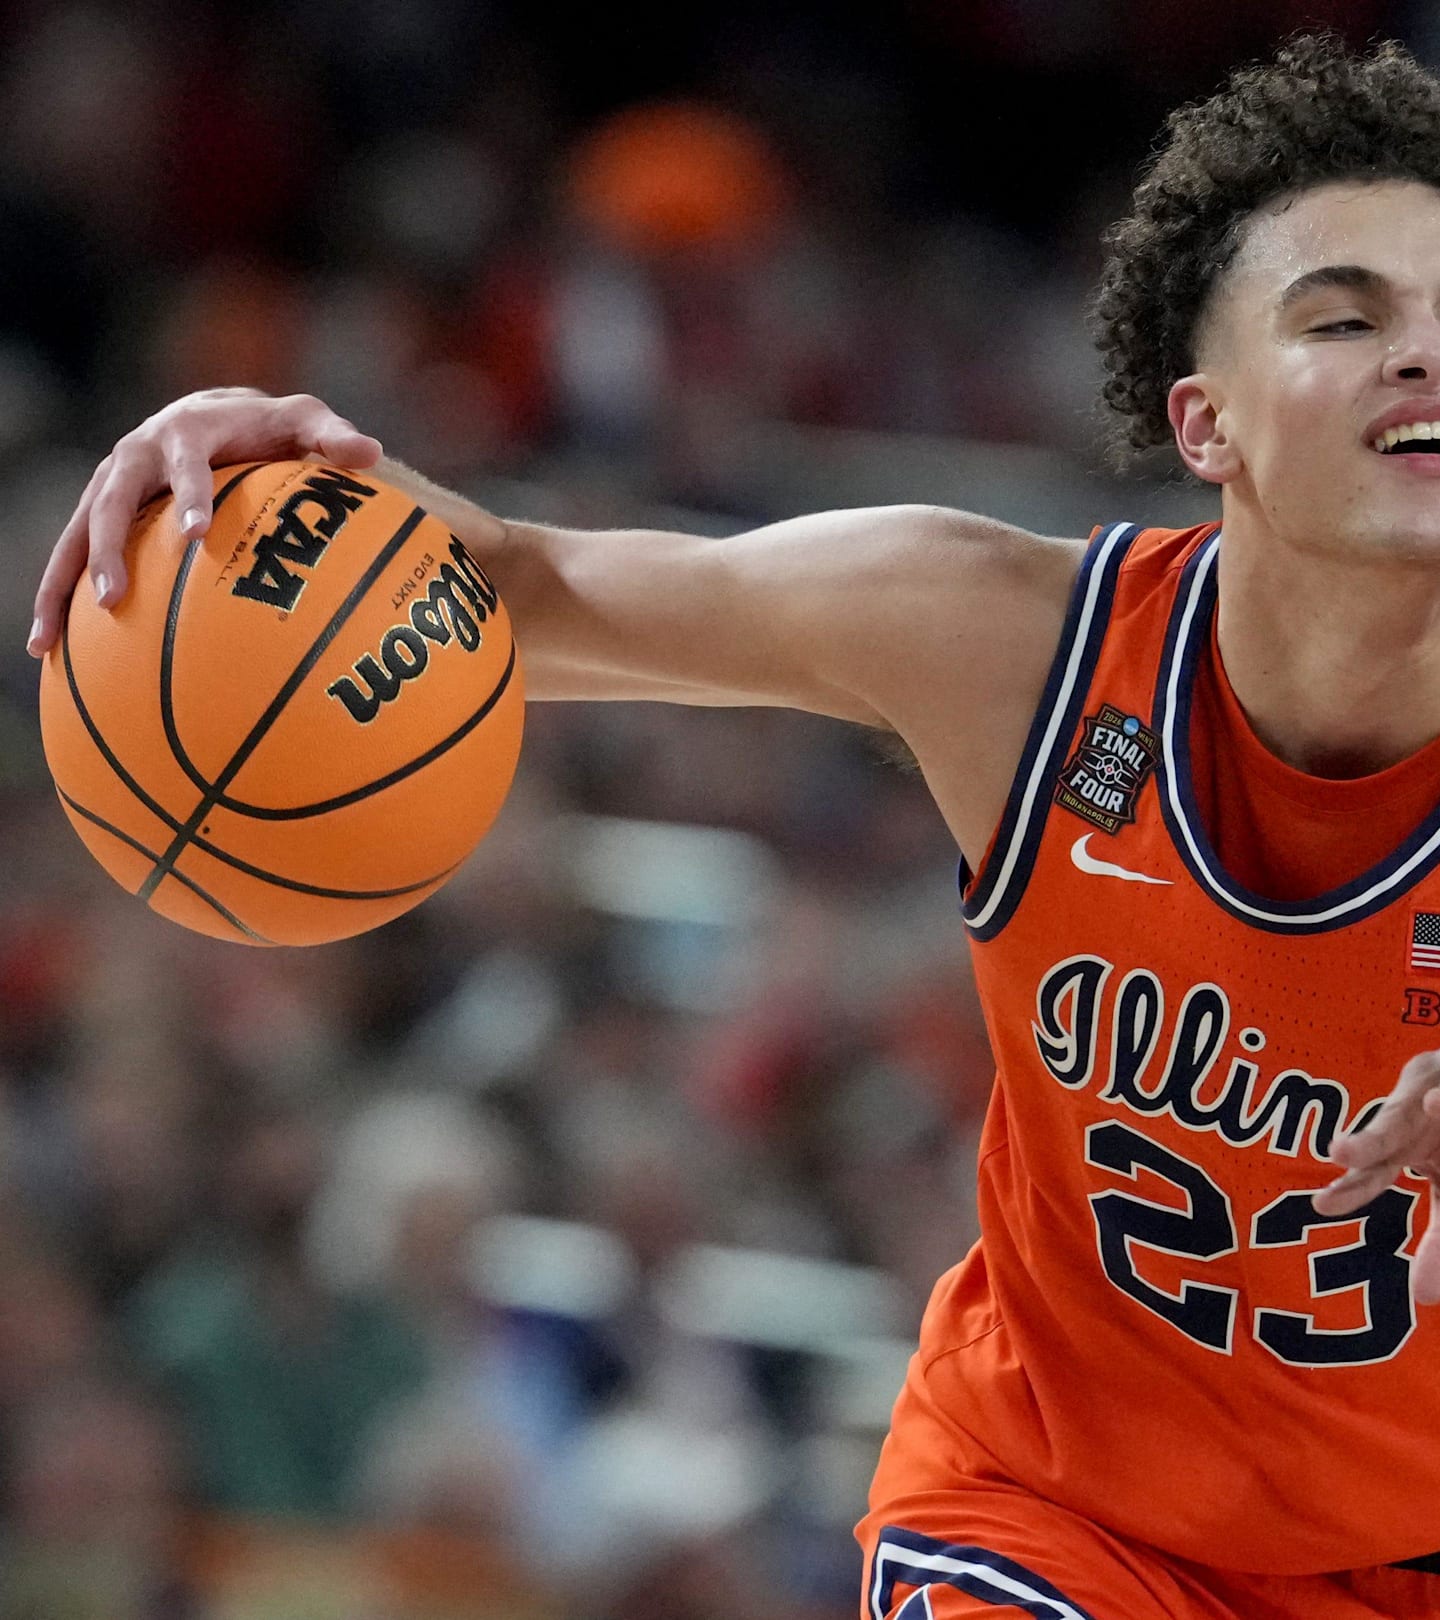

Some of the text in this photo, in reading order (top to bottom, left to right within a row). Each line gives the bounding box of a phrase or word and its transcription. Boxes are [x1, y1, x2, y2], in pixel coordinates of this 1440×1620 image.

[215, 541, 247, 586] BALL
[232, 467, 379, 613] NCAA
[391, 552, 434, 611] EVO NXT
[325, 532, 497, 725] Wilson
[1091, 726, 1146, 772] FINAL
[1062, 792, 1115, 828] INDIANAPOLIS
[1069, 769, 1125, 813] FOUR
[1031, 953, 1396, 1167] Illin
[1084, 1120, 1419, 1368] 23
